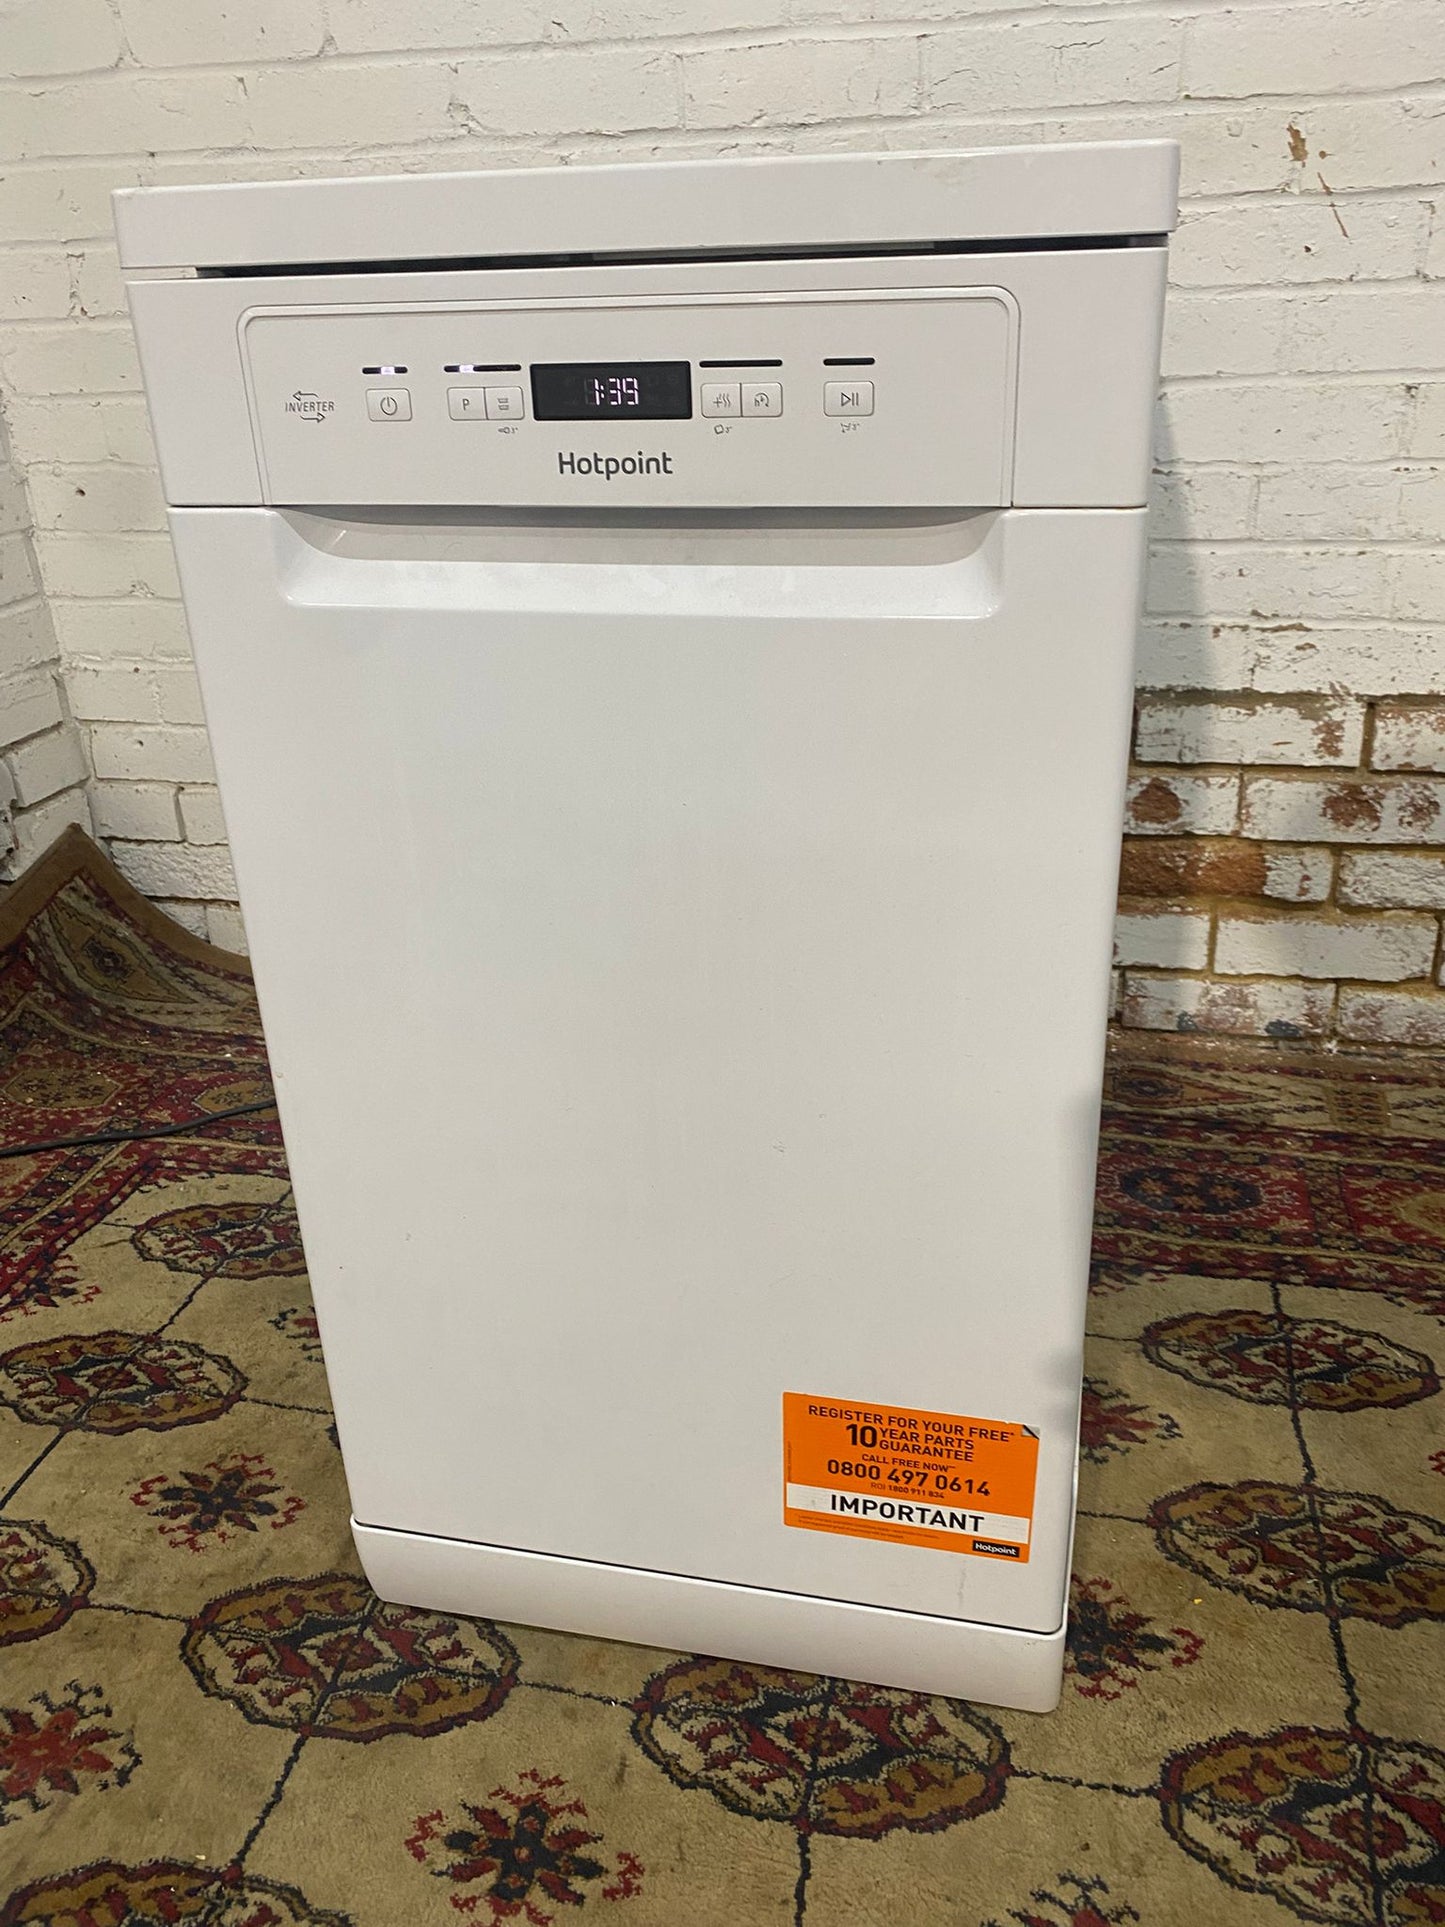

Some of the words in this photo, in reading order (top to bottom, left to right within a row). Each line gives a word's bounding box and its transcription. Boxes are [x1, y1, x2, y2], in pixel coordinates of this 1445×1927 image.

[285, 401, 335, 413] INVERTER
[462, 398, 470, 410] P
[559, 451, 673, 480] Hotpoint
[809, 1405, 883, 1425] REGISTER
[888, 1417, 917, 1429] FOR
[922, 1421, 964, 1436] YOUR
[846, 1424, 877, 1447] 10
[880, 1428, 919, 1443] YEAR
[925, 1434, 974, 1450] PARTS
[862, 1454, 889, 1464] CALL
[892, 1458, 920, 1468] FREE
[879, 1441, 974, 1462] GUARANTEE
[828, 1460, 880, 1480] 0800
[887, 1470, 928, 1487] 497
[936, 1475, 991, 1496] 0614
[831, 1494, 984, 1532] IMPORTANT
[975, 1541, 1017, 1555] Hotpoint
